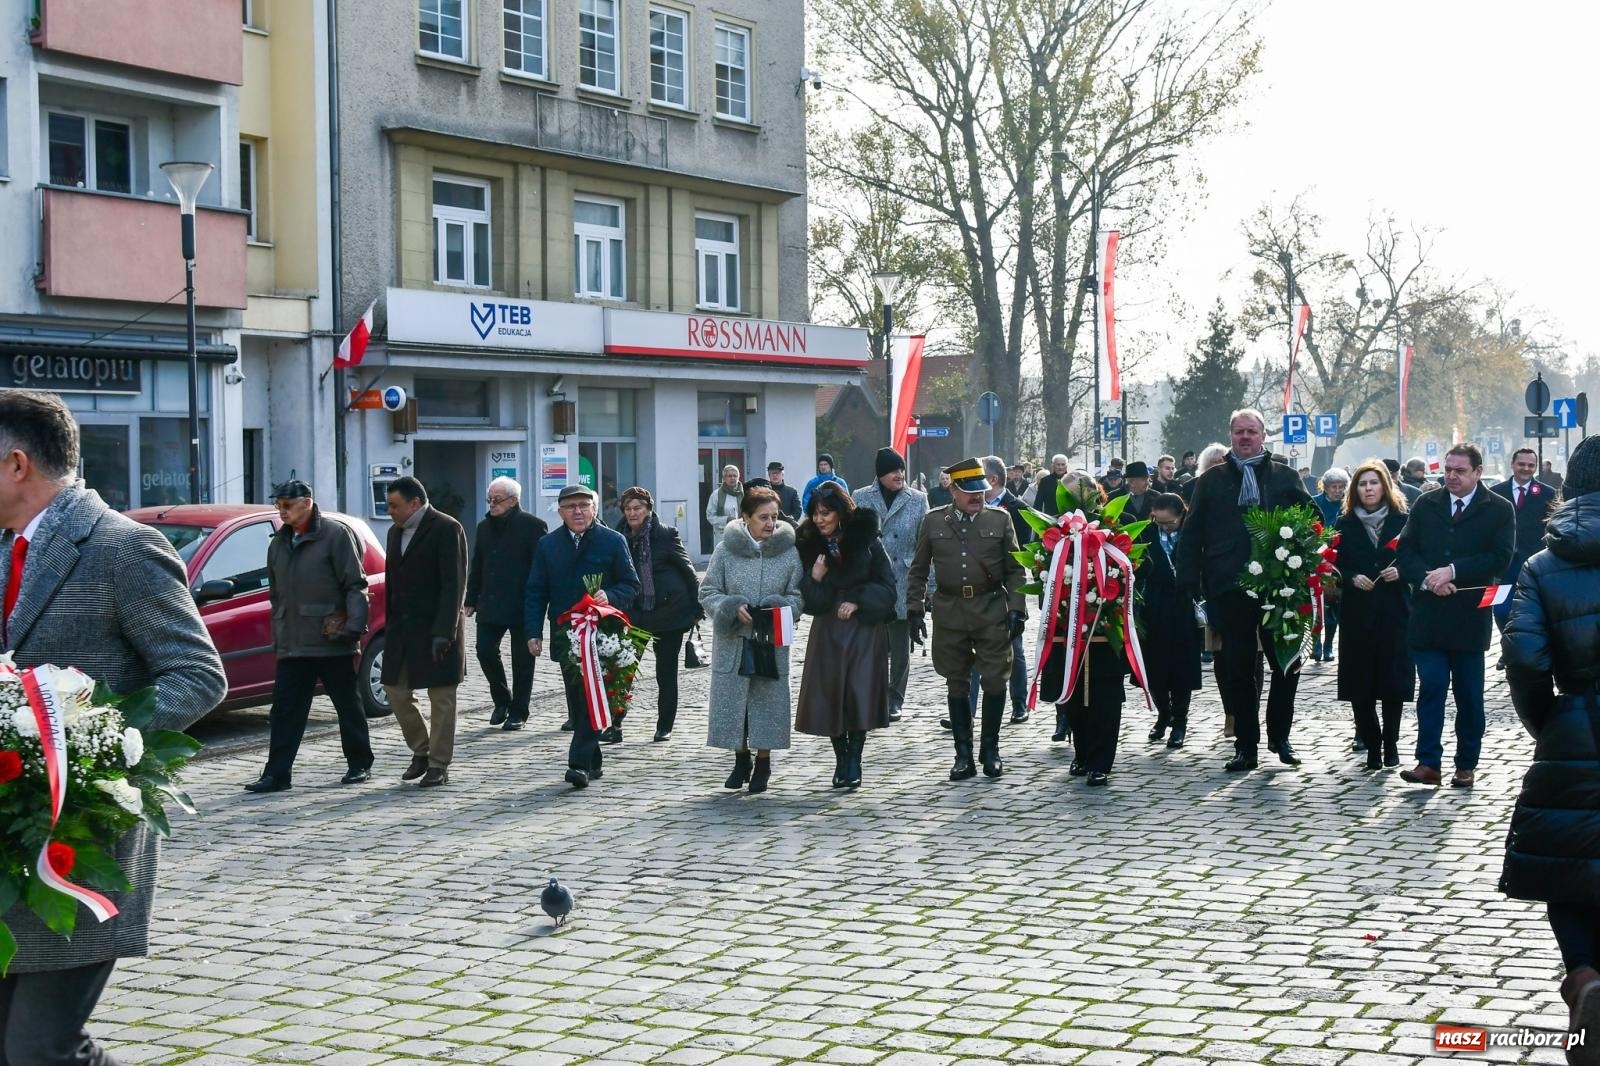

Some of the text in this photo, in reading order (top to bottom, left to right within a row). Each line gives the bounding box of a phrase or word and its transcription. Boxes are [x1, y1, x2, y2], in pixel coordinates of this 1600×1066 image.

[498, 304, 531, 325] TEB
[498, 327, 532, 337] EDUKACJA
[687, 317, 807, 353] ROSSMANN
[1107, 418, 1116, 426] P
[1288, 416, 1303, 436] P
[1319, 416, 1333, 434] P
[1427, 443, 1435, 452] P
[1491, 441, 1500, 451] P
[578, 474, 591, 484] WE
